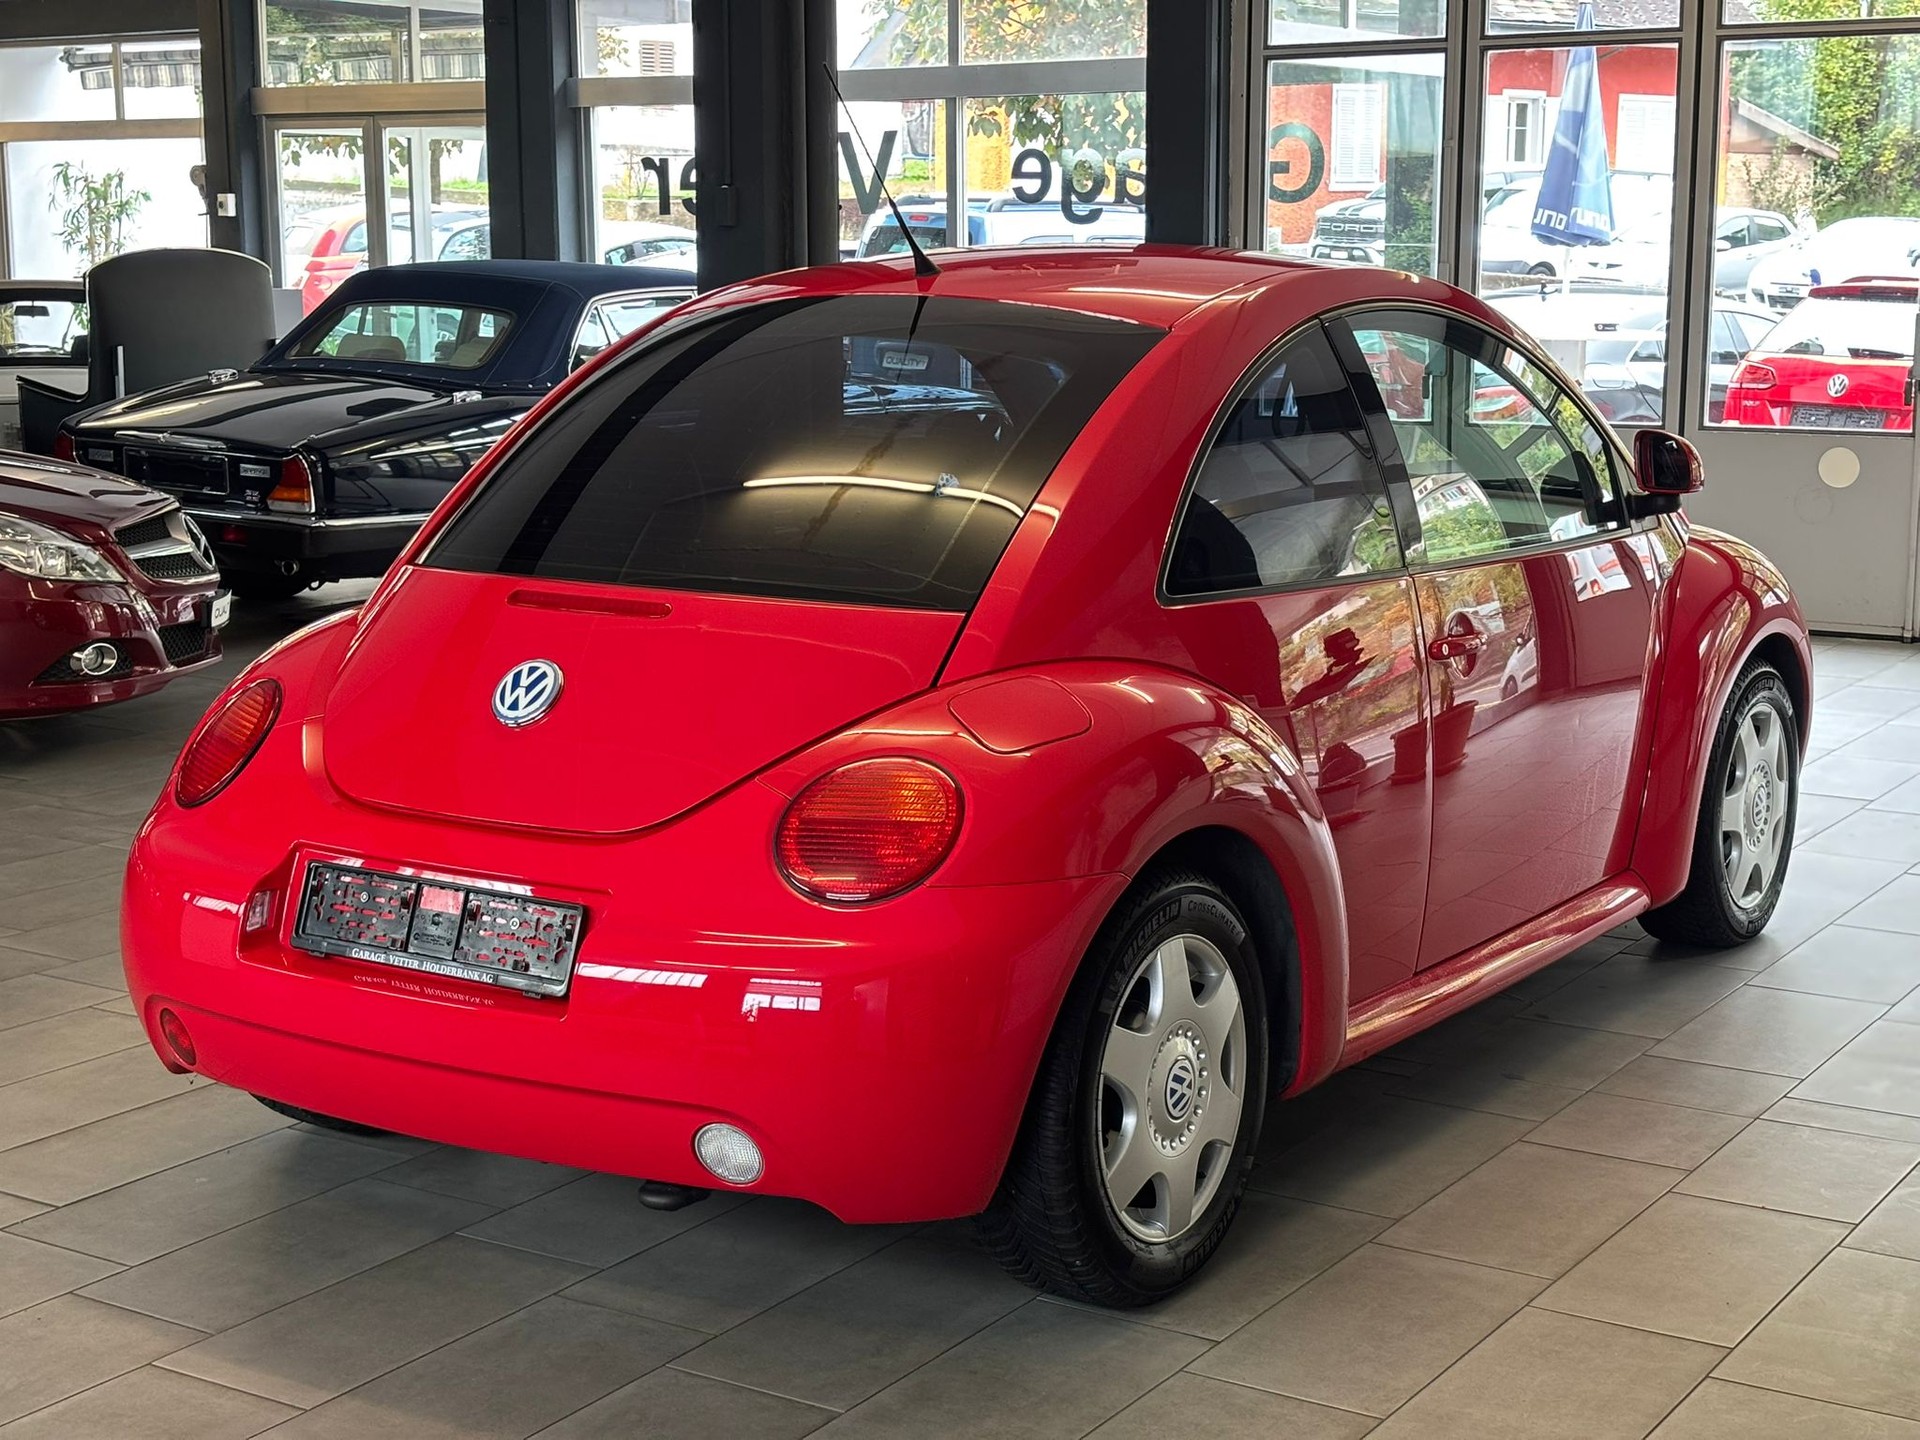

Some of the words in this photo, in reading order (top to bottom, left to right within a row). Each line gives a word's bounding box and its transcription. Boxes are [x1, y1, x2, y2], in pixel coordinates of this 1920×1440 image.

[1319, 222, 1377, 232] FORD
[1123, 899, 1180, 968] MICHELIN
[352, 947, 386, 963] GARAGE
[389, 954, 419, 969] VETTER
[422, 961, 481, 980] HOLDERBANK
[481, 973, 494, 983] AG
